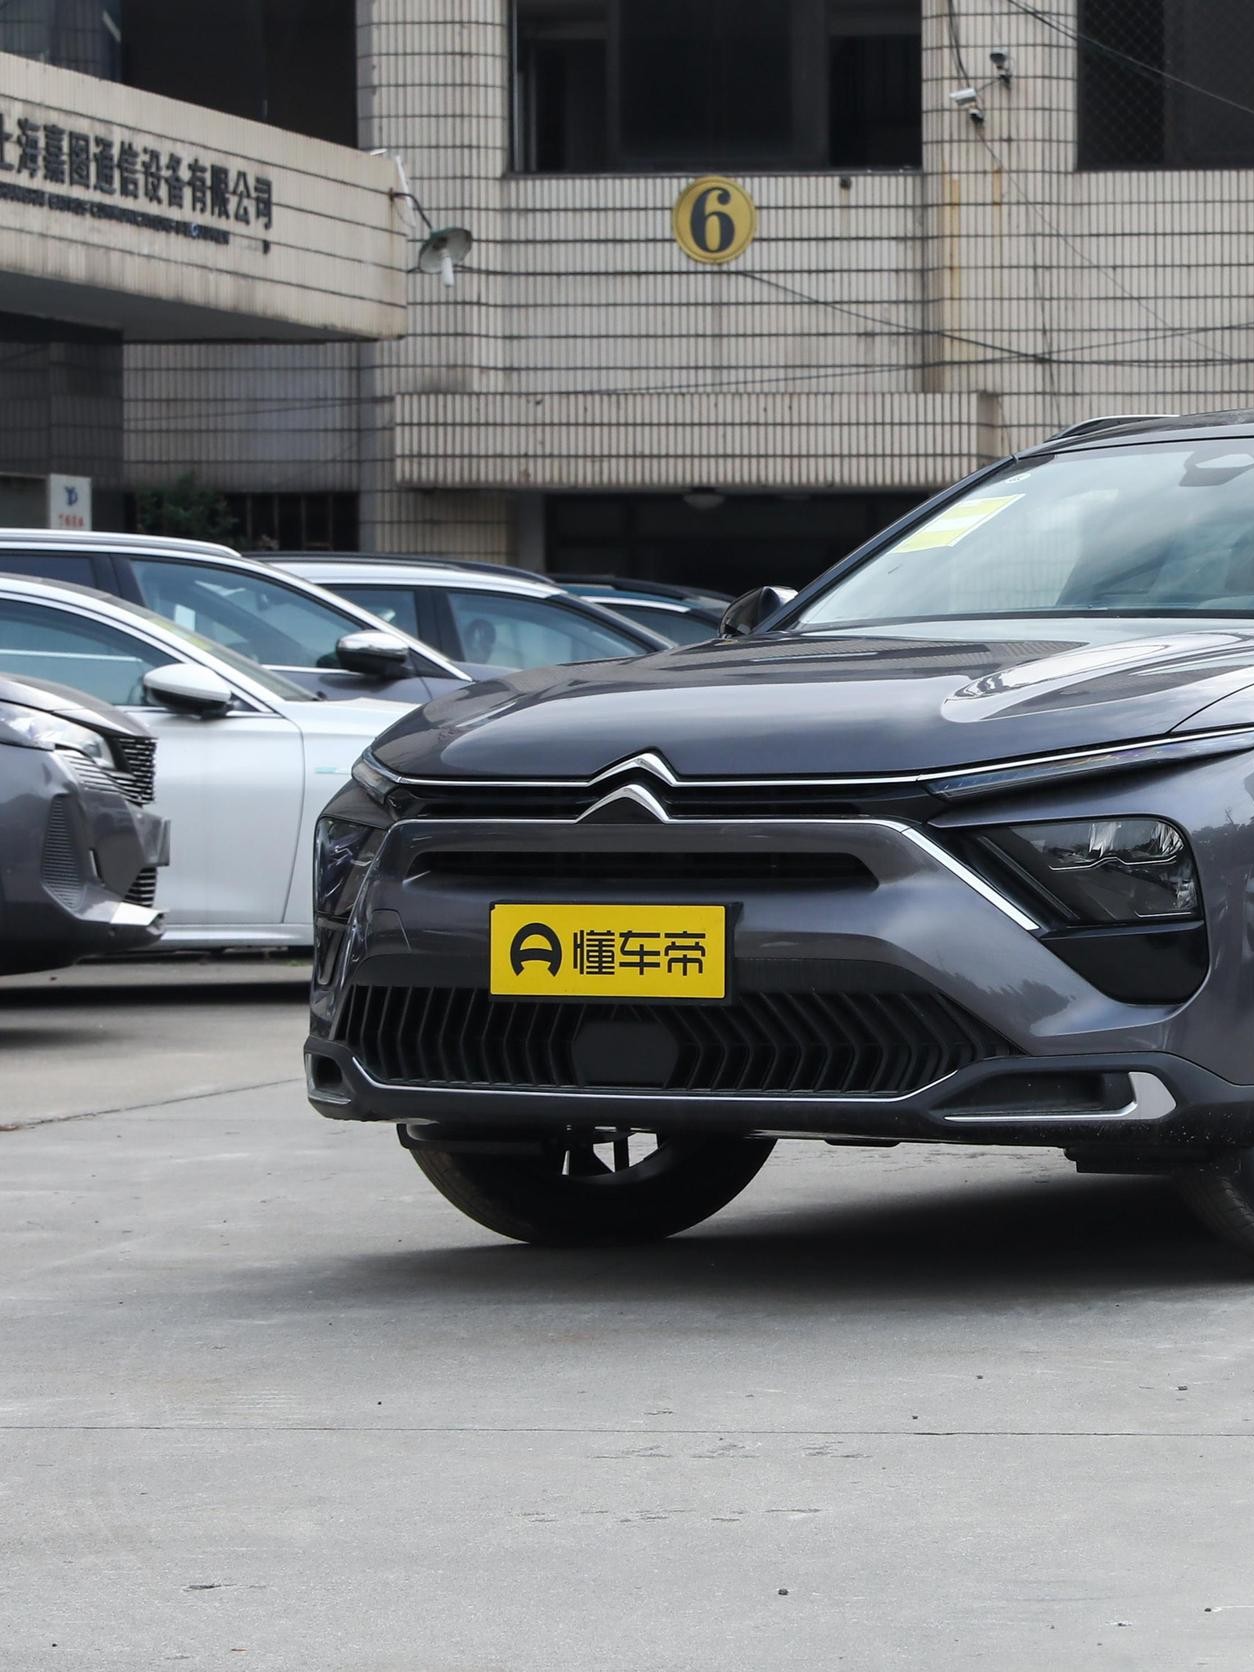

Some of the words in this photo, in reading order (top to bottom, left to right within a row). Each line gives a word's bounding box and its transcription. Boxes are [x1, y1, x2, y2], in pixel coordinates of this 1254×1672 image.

[690, 187, 735, 253] 6
[573, 930, 706, 976] 懂车帝
